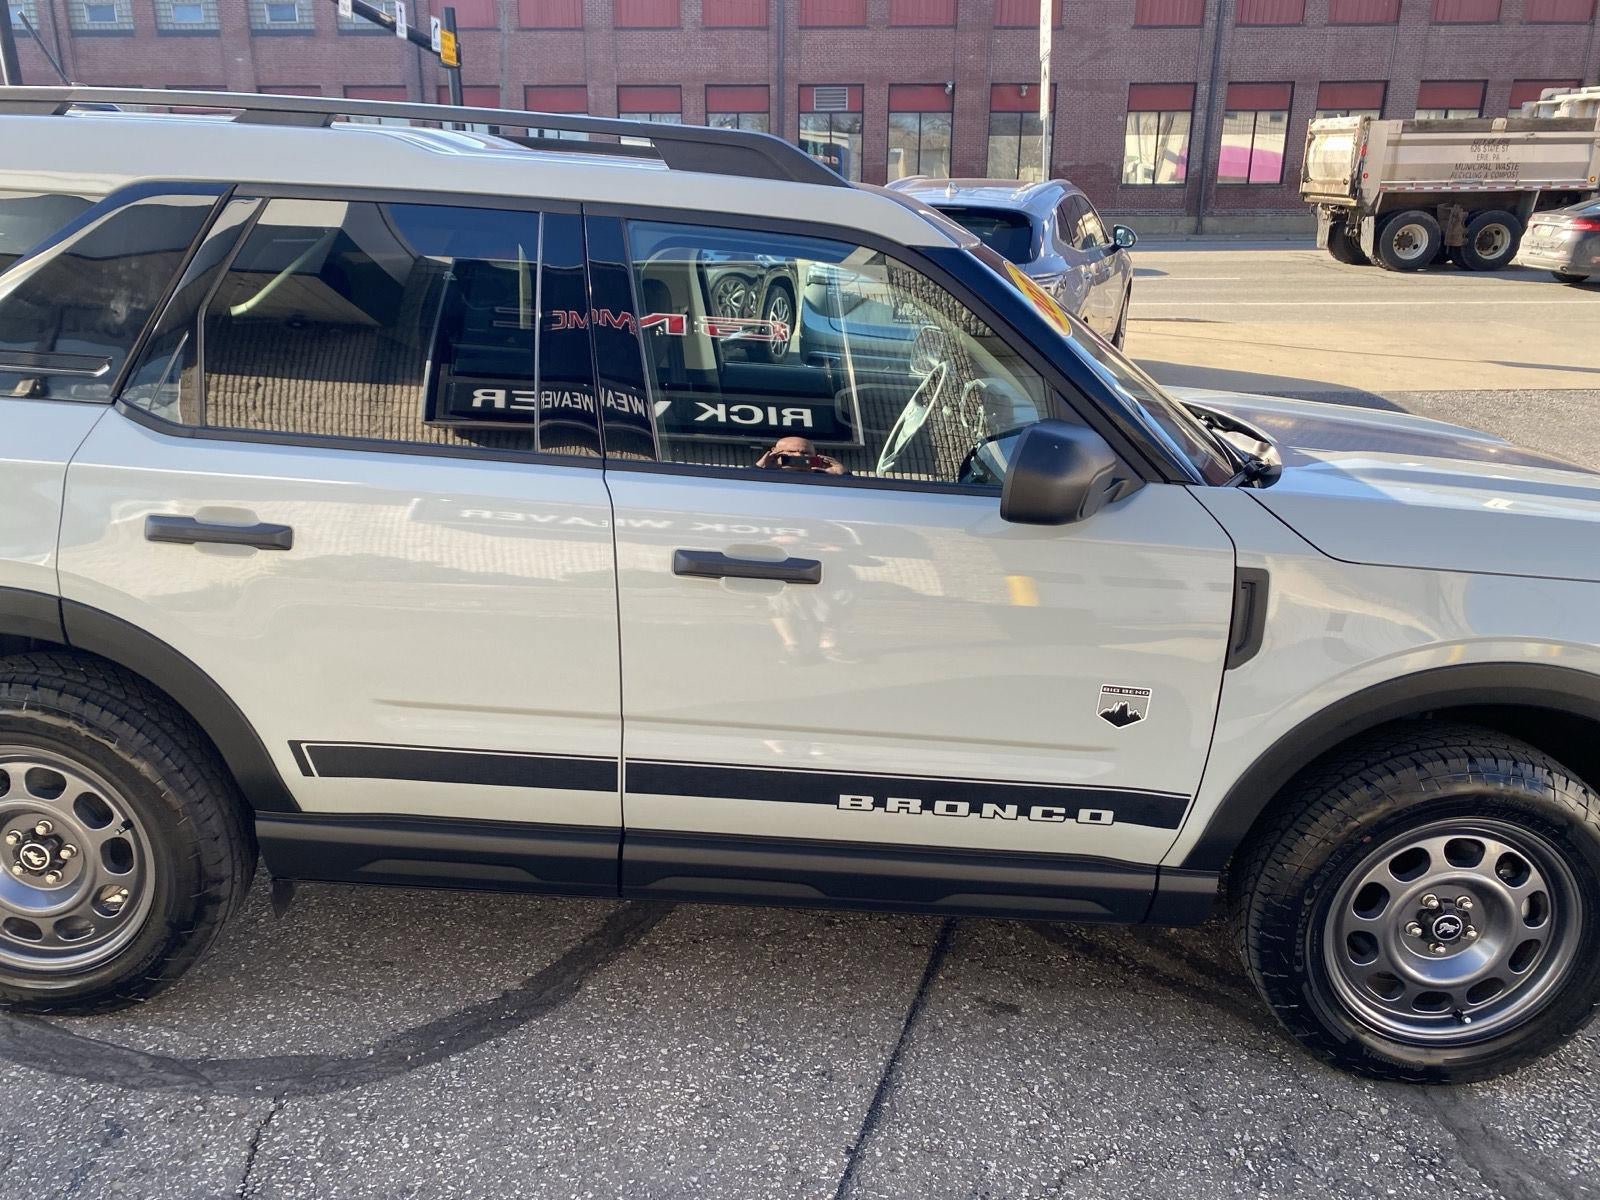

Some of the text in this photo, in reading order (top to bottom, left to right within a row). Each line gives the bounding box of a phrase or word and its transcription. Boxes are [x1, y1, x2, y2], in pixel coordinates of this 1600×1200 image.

[1455, 162, 1520, 171] MUNICIPAL WASTE
[1450, 171, 1481, 179] RECYCLING
[1490, 171, 1520, 179] COMPOST
[837, 794, 1115, 826] BRONCO
